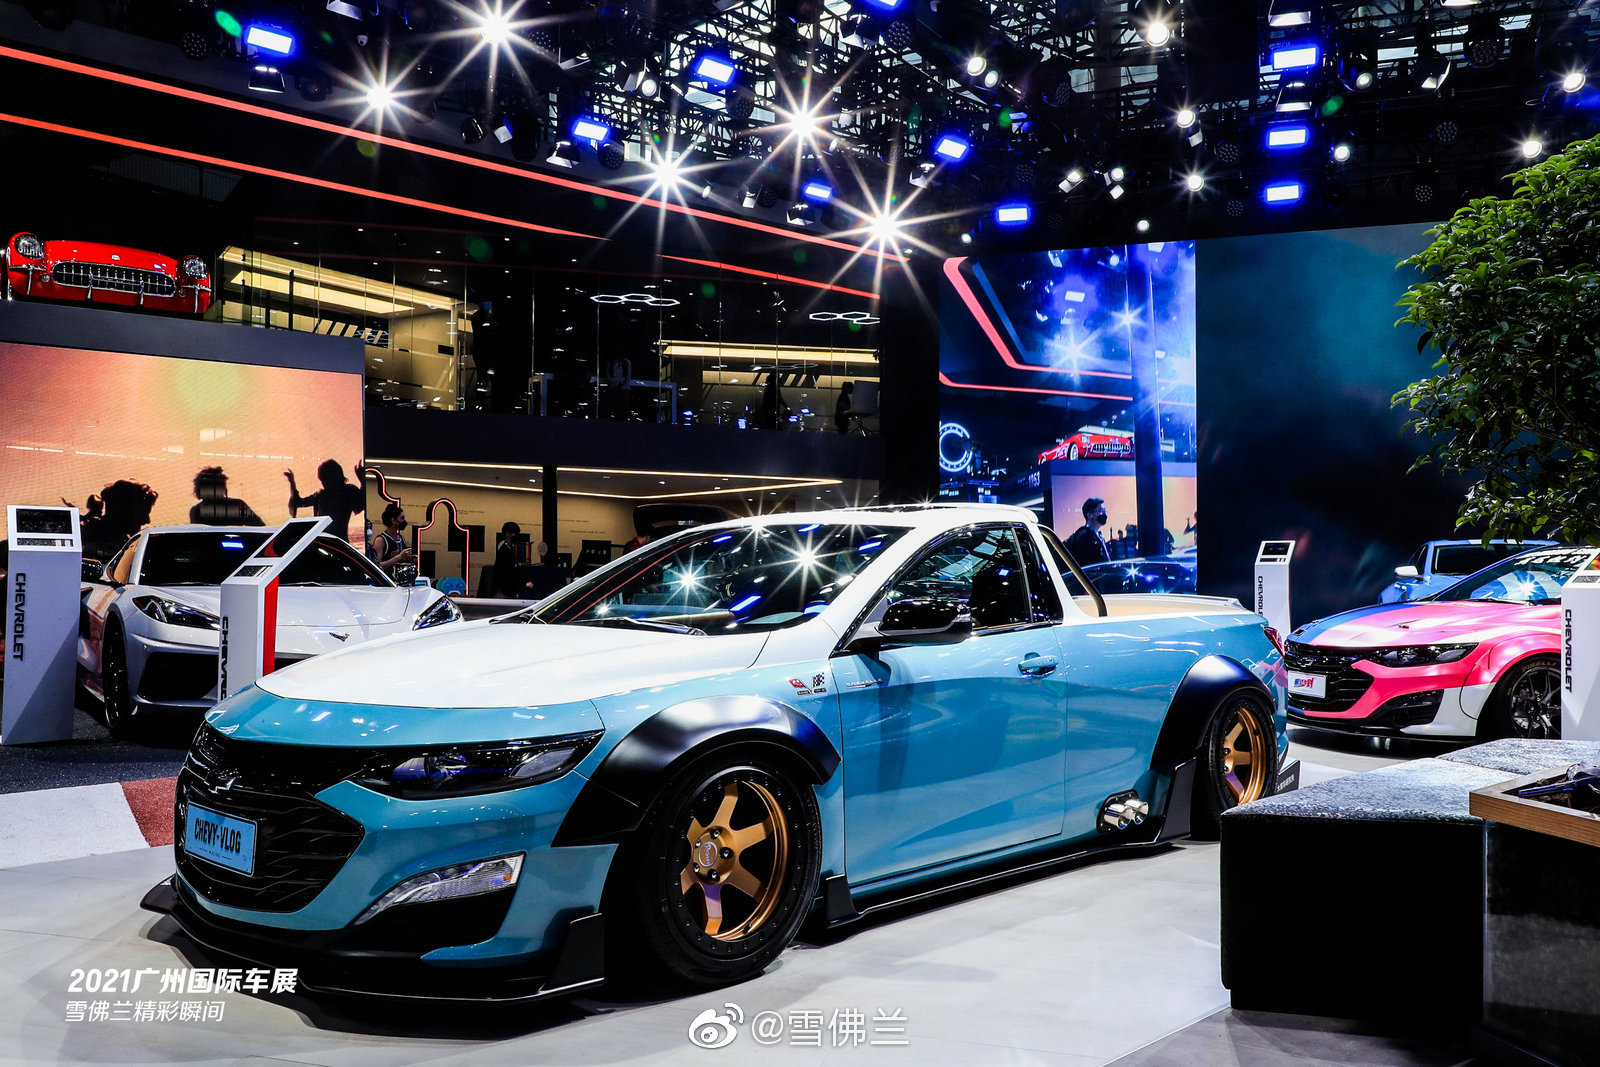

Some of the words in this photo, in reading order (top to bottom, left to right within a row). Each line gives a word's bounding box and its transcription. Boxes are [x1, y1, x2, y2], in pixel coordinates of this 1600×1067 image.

[13, 573, 26, 661] CHEVROLET
[1520, 660, 1557, 673] PIRELLI
[194, 817, 242, 854] CHEVY-VLOG
